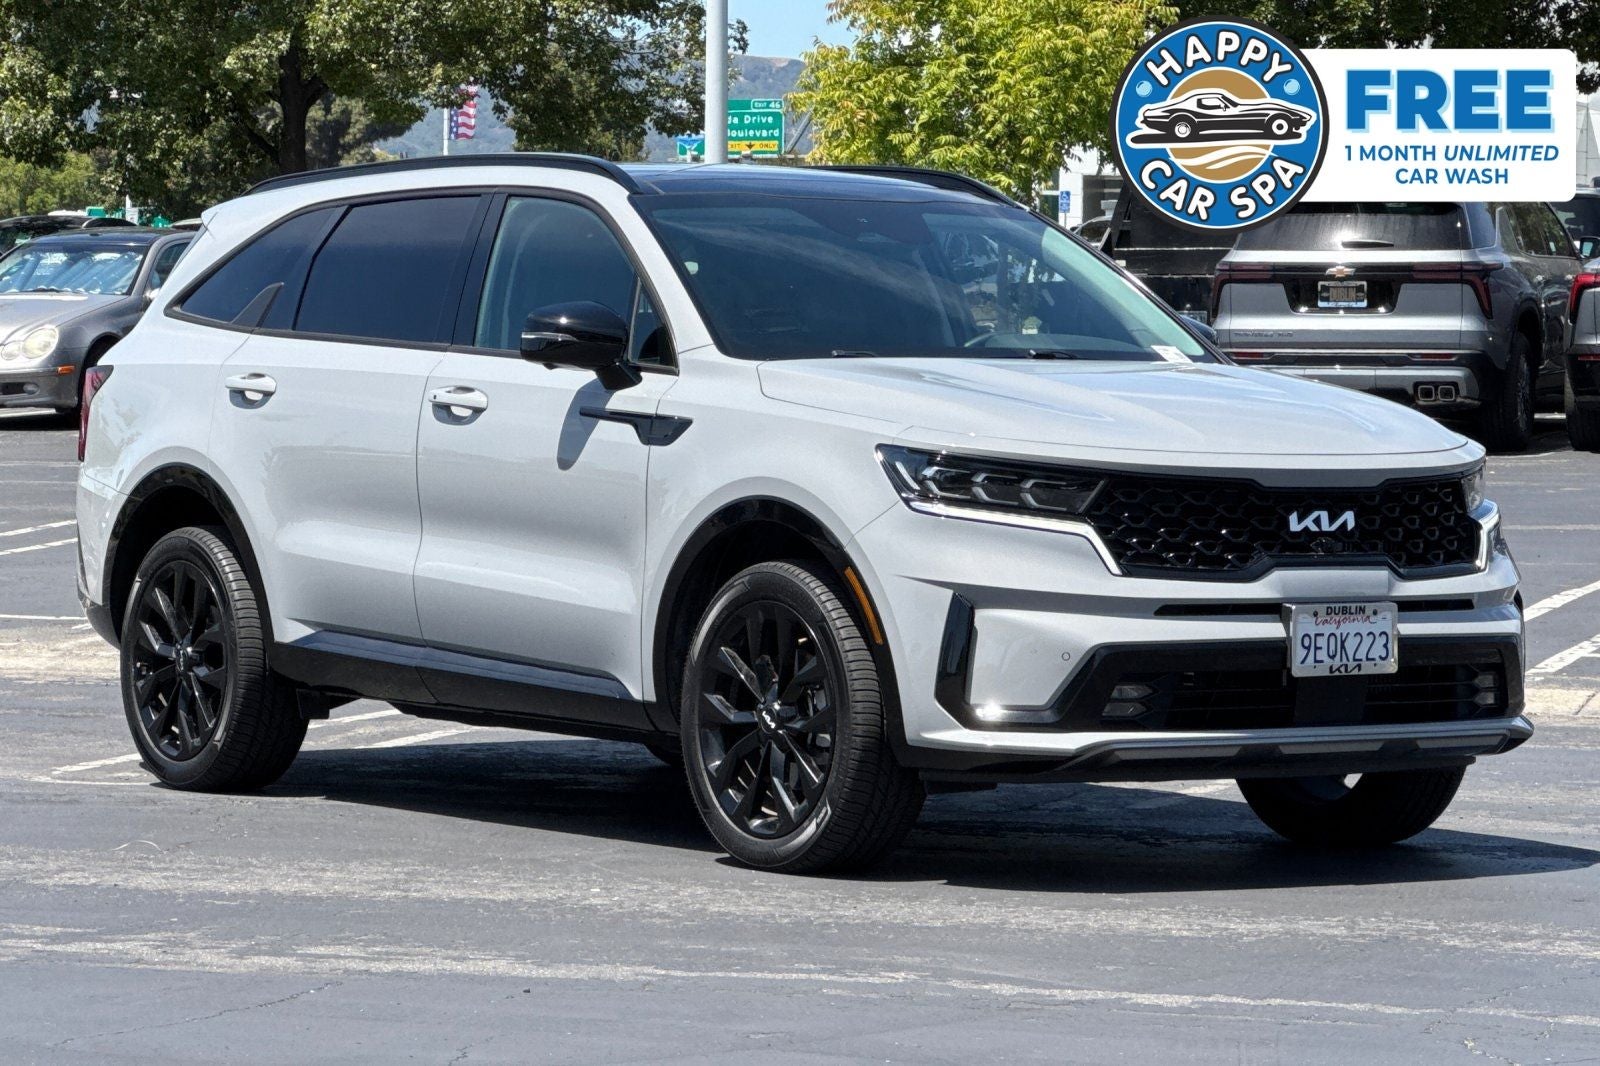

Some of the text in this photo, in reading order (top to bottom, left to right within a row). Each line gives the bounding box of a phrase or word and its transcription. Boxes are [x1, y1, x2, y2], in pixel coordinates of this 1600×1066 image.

[769, 101, 781, 109] 46
[743, 115, 773, 124] Drive
[1289, 510, 1355, 532] KIA
[1326, 605, 1366, 616] DUBLIN
[1314, 614, 1377, 630] California
[1300, 631, 1389, 665] 9EQK223
[1329, 663, 1362, 674] KIA
